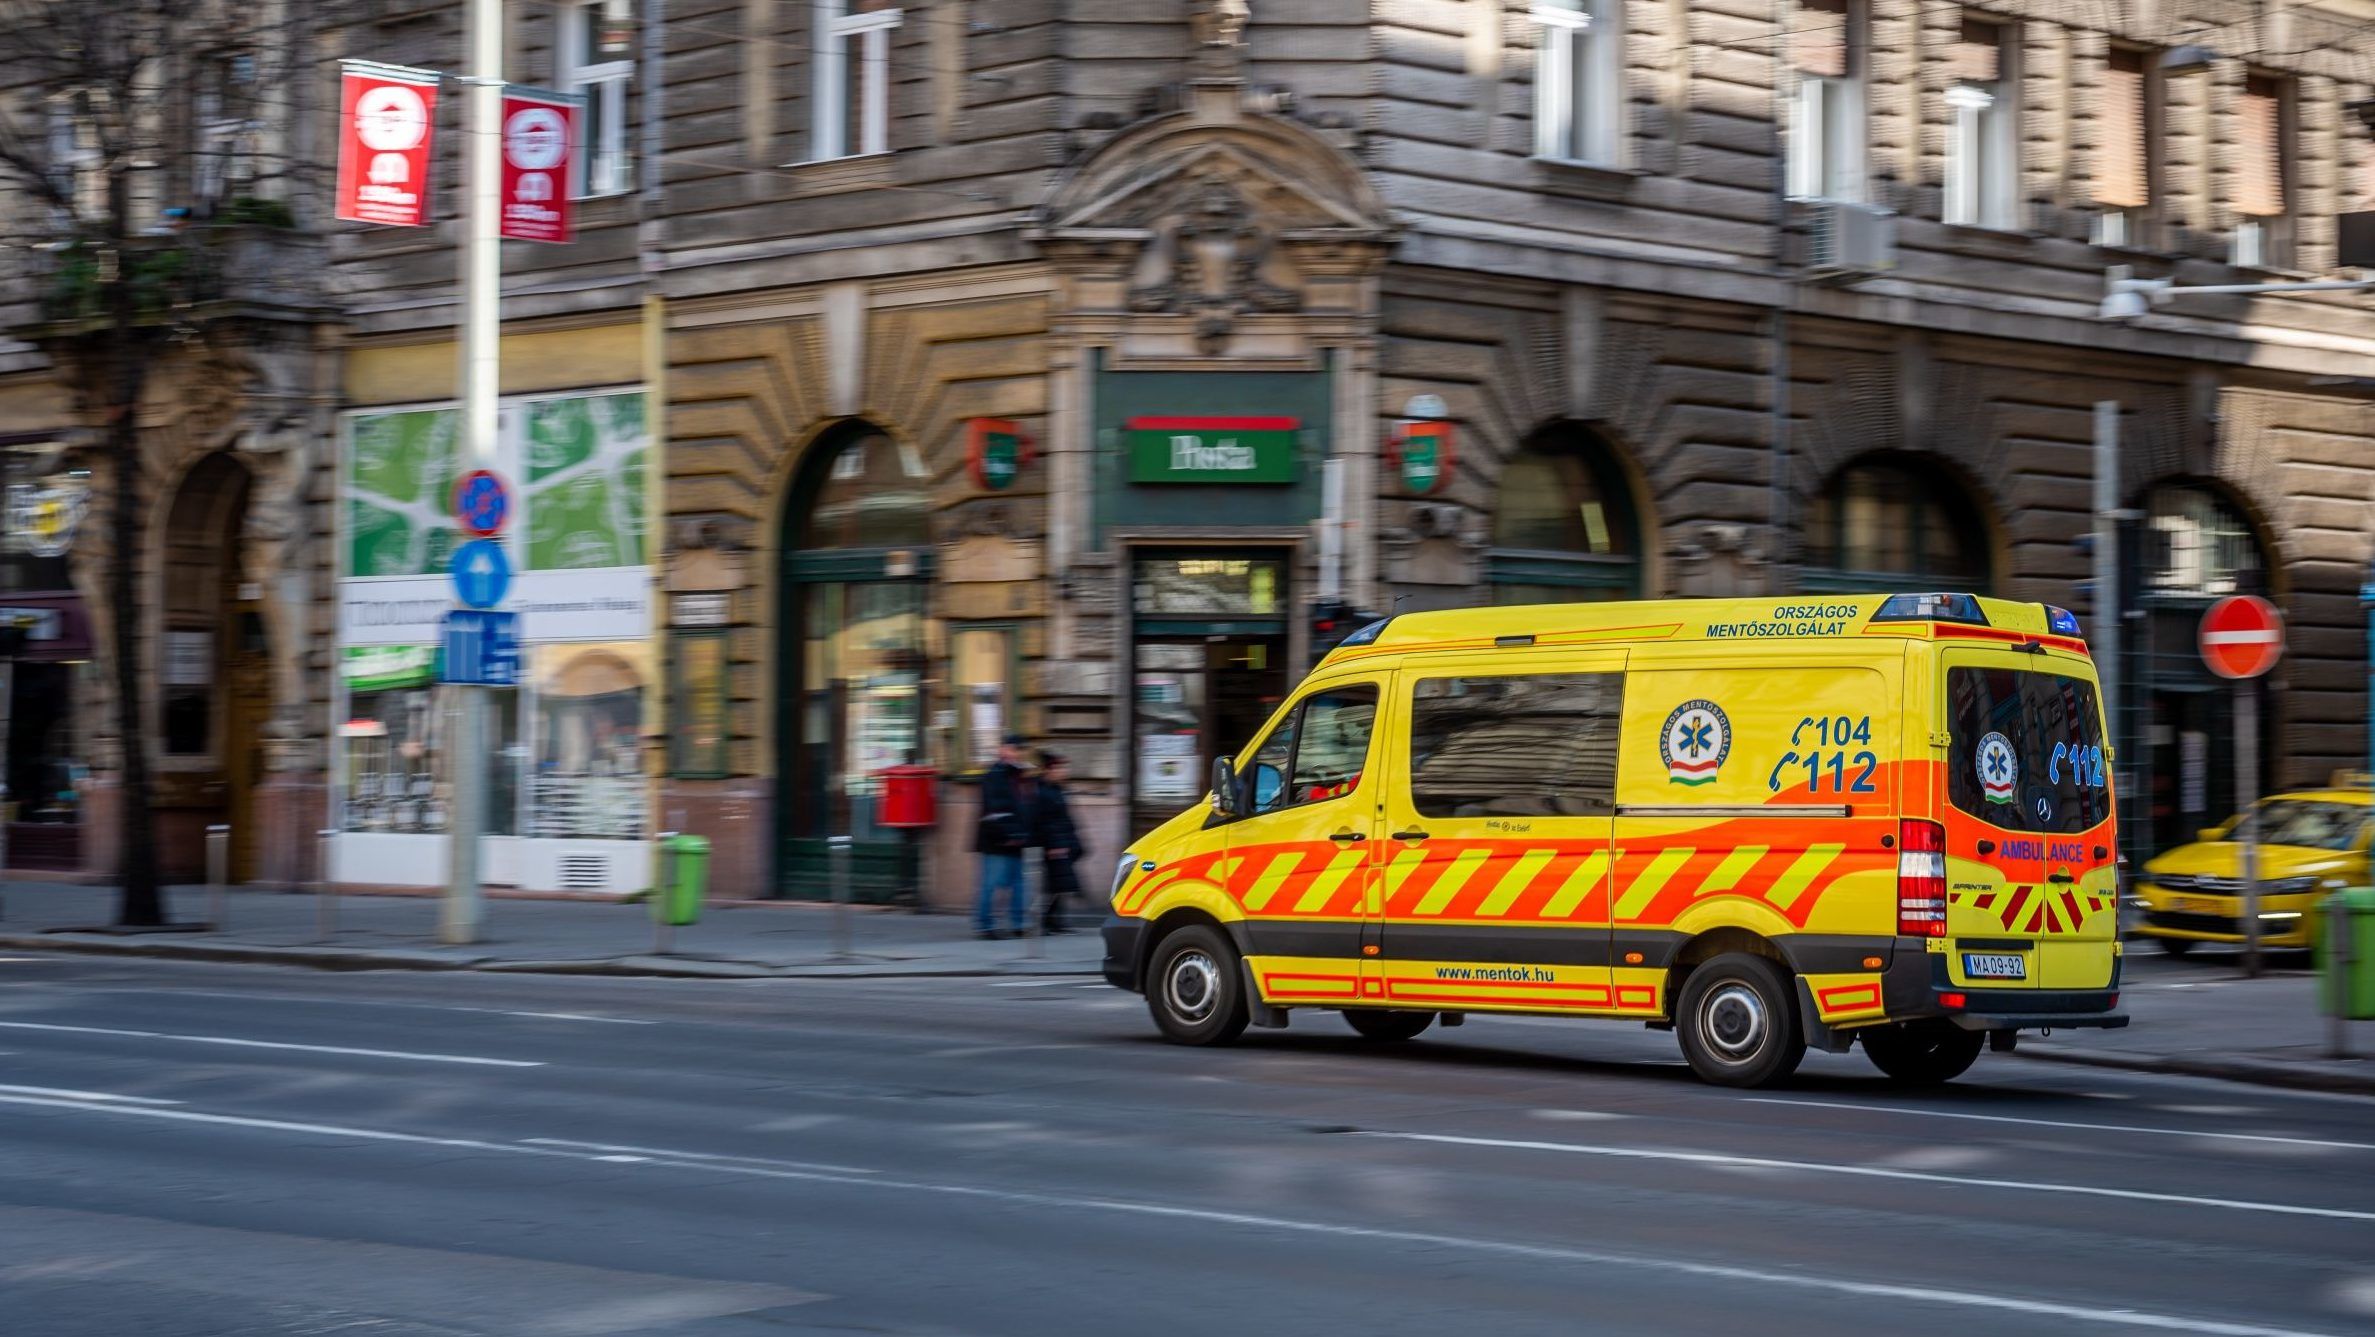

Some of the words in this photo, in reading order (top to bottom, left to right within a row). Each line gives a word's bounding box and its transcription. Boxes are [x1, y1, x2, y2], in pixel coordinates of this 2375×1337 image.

[1774, 603, 1858, 619] ORSZÁGOS
[1706, 620, 1846, 637] MENTŐSZOLGÁLAT
[1816, 716, 1871, 746] 104
[1802, 751, 1877, 792] 112
[2069, 744, 2104, 786] 112
[2000, 840, 2084, 863] AMBULANCE
[1436, 966, 1554, 982] www.mentok.hu
